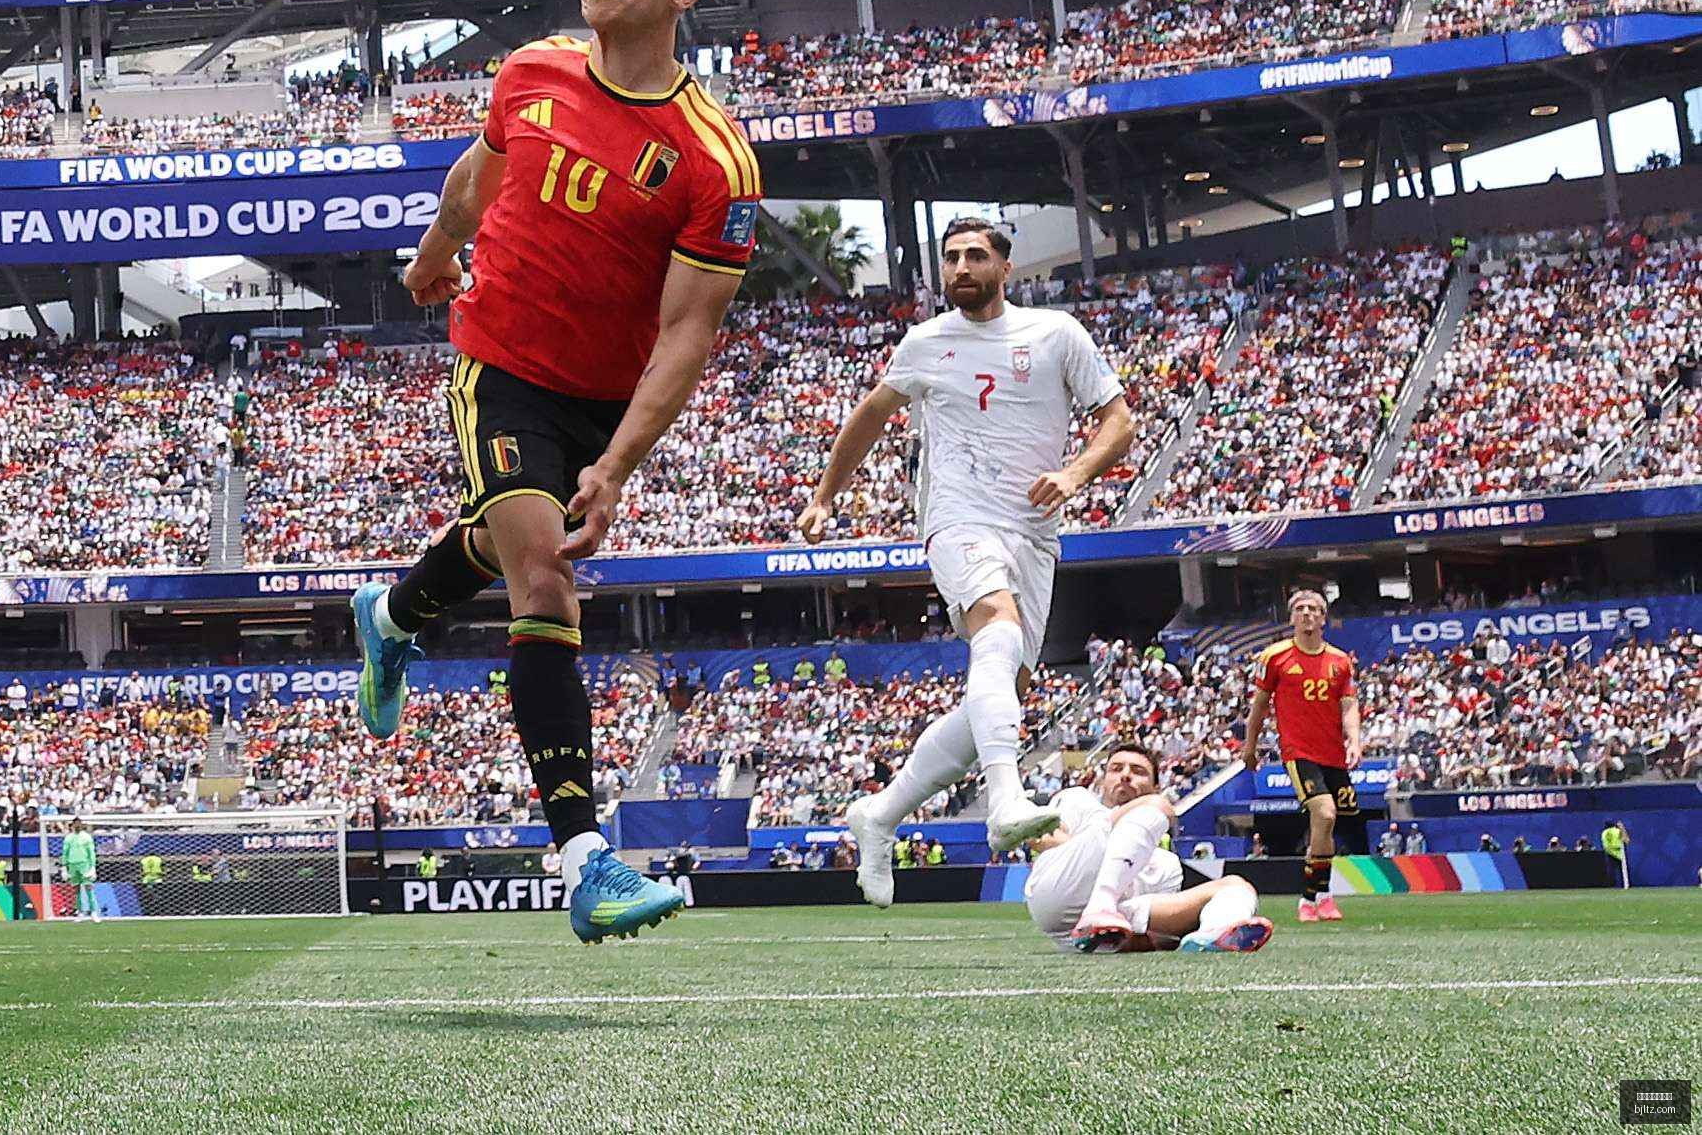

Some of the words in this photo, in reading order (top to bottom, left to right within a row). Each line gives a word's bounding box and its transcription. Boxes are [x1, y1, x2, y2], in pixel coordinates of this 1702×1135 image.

[60, 158, 123, 183] FIFA
[125, 152, 232, 181] WORLD
[234, 150, 296, 176] CUP
[298, 144, 403, 172] 2026
[540, 142, 610, 214] 10
[58, 204, 219, 242] WORLD
[227, 199, 316, 236] CUP
[322, 193, 439, 232] 202
[975, 374, 996, 411] 7
[1394, 512, 1438, 534] LOS
[1442, 503, 1545, 530] ANGELES
[767, 554, 812, 572] FIFA
[812, 550, 888, 571] WORLD
[258, 575, 300, 592] LOS
[1392, 620, 1464, 644] LOS
[1474, 607, 1651, 642] ANGELES
[291, 671, 360, 693] 202
[1303, 679, 1329, 701] 22
[531, 746, 587, 764] RBFA
